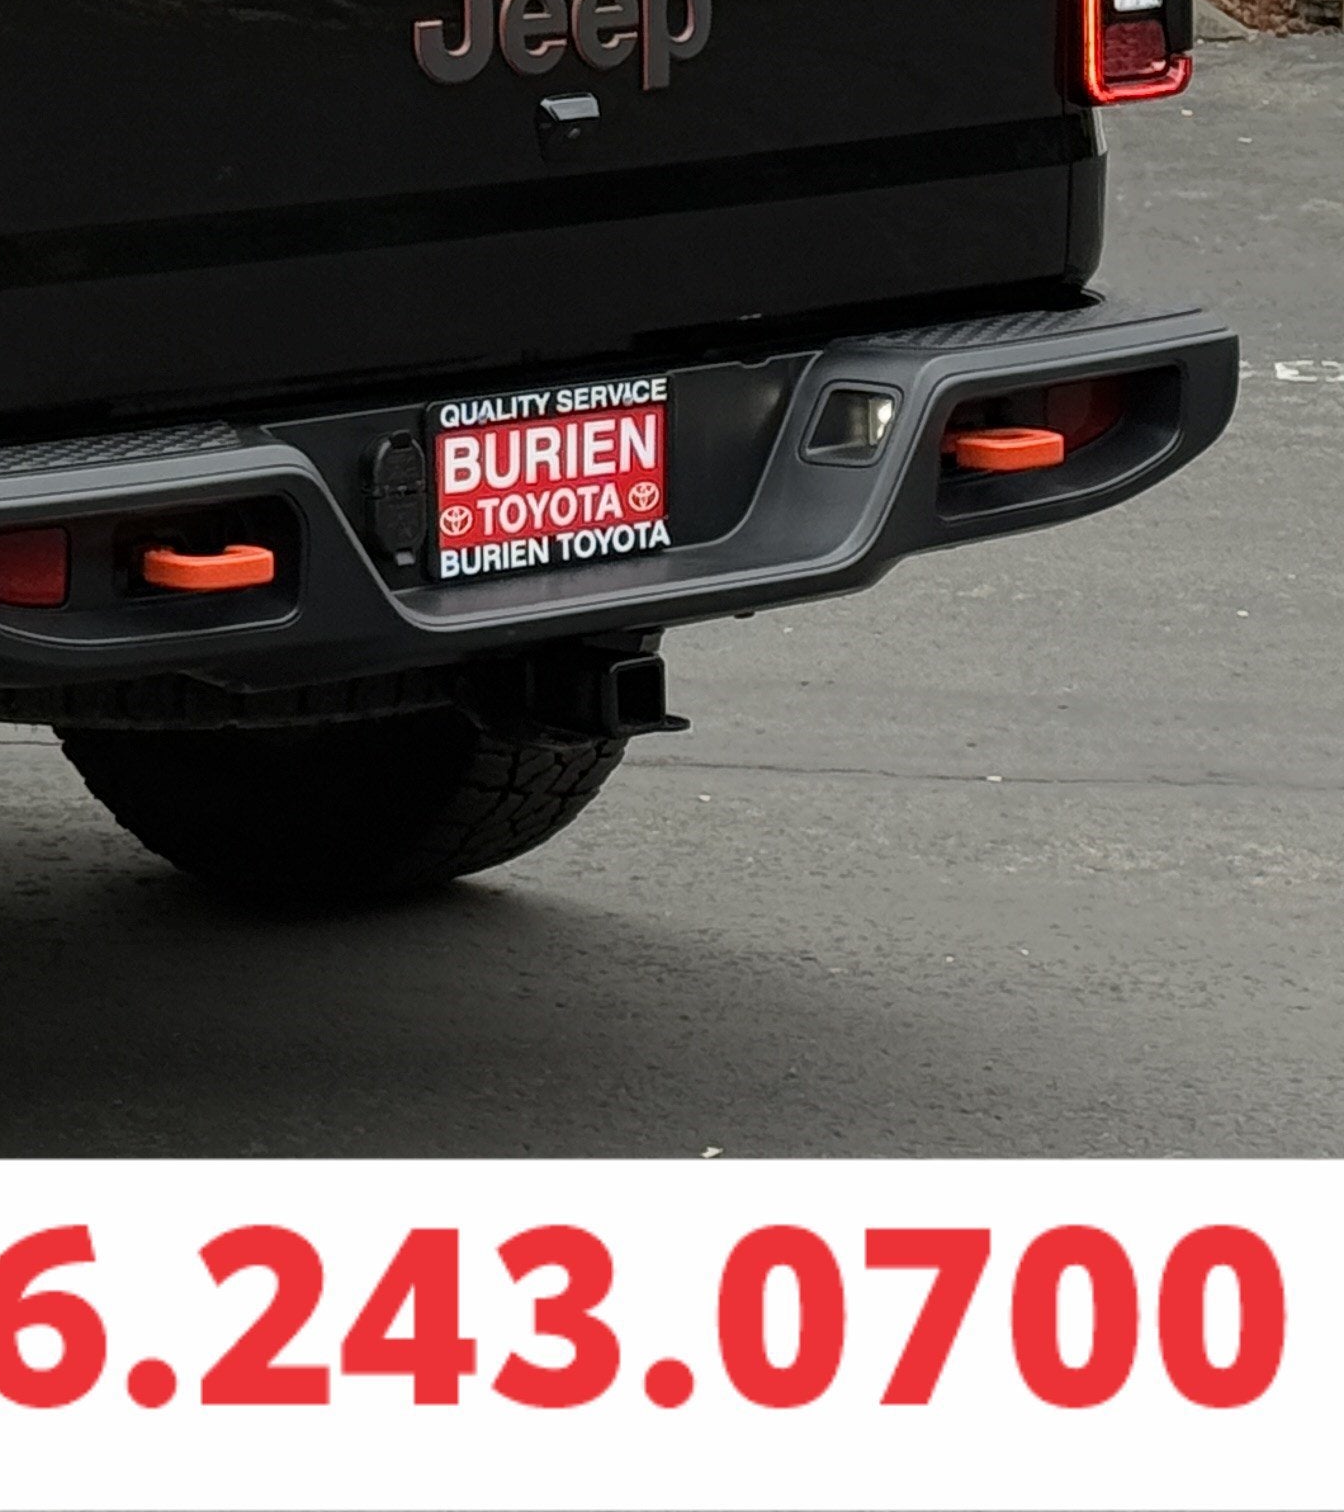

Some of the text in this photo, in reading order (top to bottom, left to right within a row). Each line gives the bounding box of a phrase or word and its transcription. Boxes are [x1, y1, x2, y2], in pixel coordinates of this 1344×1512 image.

[440, 378, 667, 428] QUALITY SERVICE
[443, 414, 656, 495] BURIEN
[477, 483, 624, 536] TOYOTA
[440, 520, 671, 579] BURIEN TOYOTA
